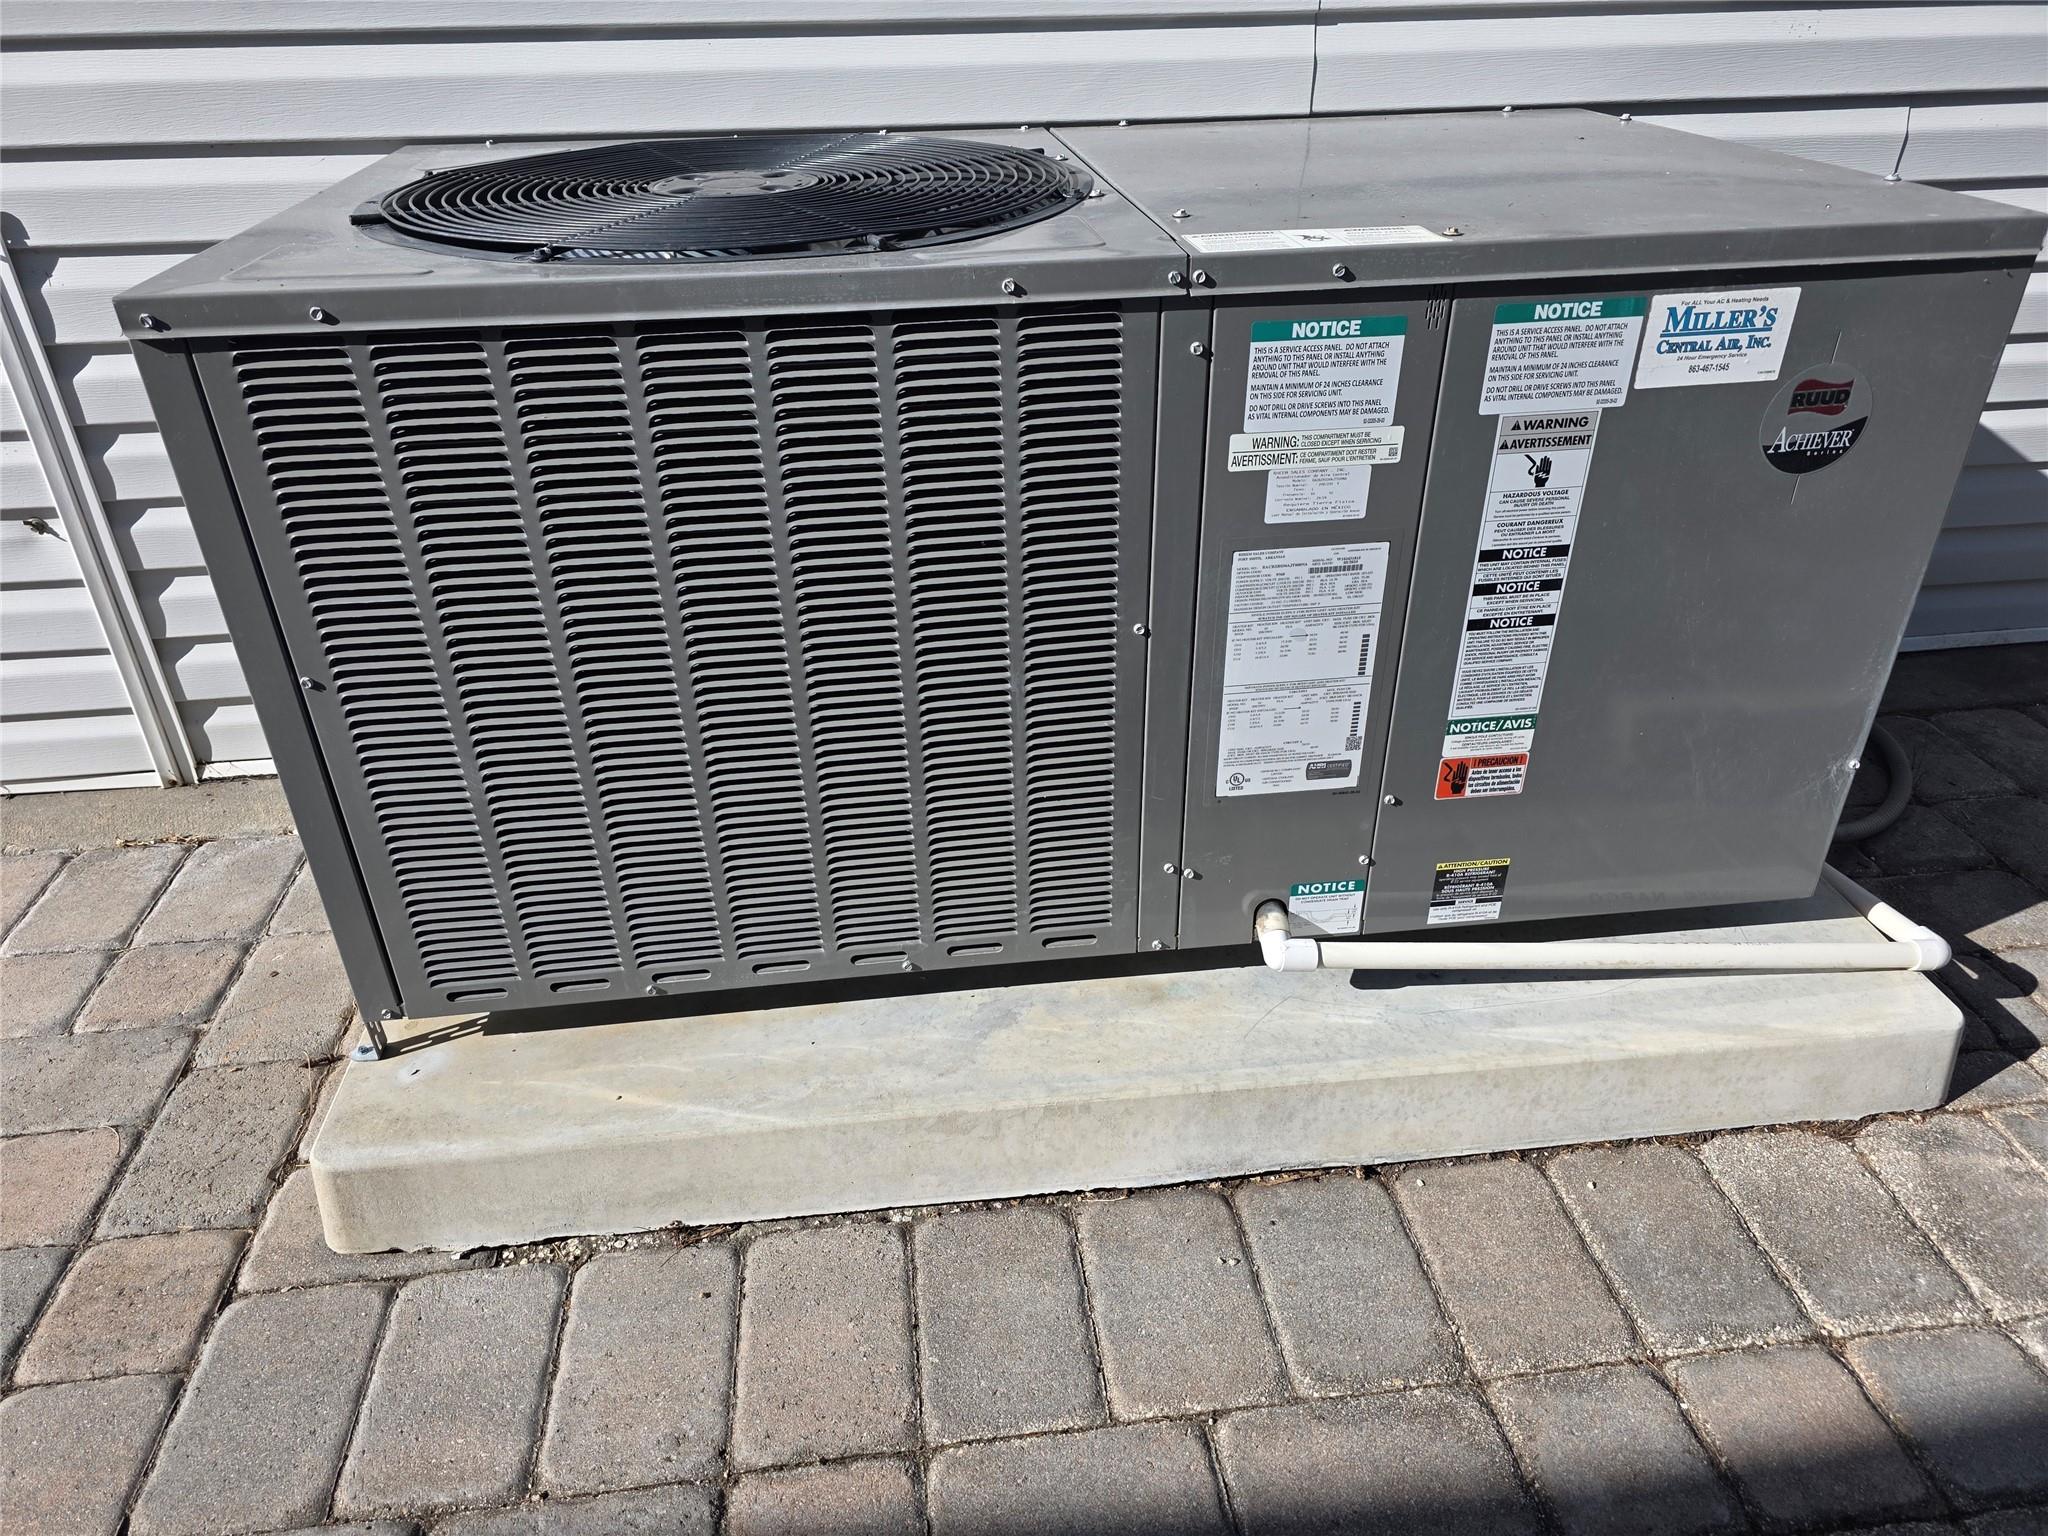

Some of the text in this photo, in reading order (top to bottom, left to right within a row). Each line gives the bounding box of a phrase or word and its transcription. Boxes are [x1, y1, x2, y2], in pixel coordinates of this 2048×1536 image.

[1534, 301, 1602, 319] NOTICE
[1292, 320, 1361, 337] NOTICE
[1509, 328, 1515, 336] IS
[1515, 328, 1520, 336] A
[1520, 327, 1542, 335] SERVICE
[1543, 326, 1563, 334] ACCESS
[1585, 324, 1594, 332] DO
[1594, 323, 1607, 331] NOT
[1606, 322, 1628, 330] ATTACH
[1494, 336, 1523, 345] ANYTHING
[1545, 334, 1562, 342] PANEL
[1594, 331, 1623, 339] ANYTHING
[1254, 341, 1390, 354] THIS IS A SERVICE ACCESS PANEL. DO NOT ATTACH
[1492, 345, 1517, 353] AROUND
[1517, 344, 1531, 352] UNIT
[1532, 343, 1546, 351] THAT
[1547, 342, 1568, 350] WOULD
[1568, 340, 1597, 348] INTERFERE
[1253, 354, 1282, 362] ANYTHING
[1284, 354, 1292, 362] TO
[1292, 353, 1305, 361] THIS
[1324, 352, 1332, 360] OR
[1333, 351, 1354, 359] INSTALL
[1355, 350, 1385, 358] ANYTHING
[1491, 350, 1558, 361] REMOVAL OF THIS PANEL.
[1252, 363, 1277, 371] AROUND
[1277, 362, 1292, 370] UNIT
[1330, 359, 1359, 367] INTERFERE
[1489, 365, 1517, 373] MAINTAIN
[1523, 363, 1551, 371] MINIMUM
[1552, 362, 1560, 370] OF
[1588, 359, 1618, 368] CLEARANCE
[1688, 362, 1729, 373] 863-467-1545
[1251, 371, 1278, 379] REMOVAL
[1279, 370, 1287, 378] OF
[1352, 378, 1383, 386] CLEARANCE
[1249, 392, 1258, 400] ON
[1273, 391, 1285, 399] SIDE
[1298, 389, 1327, 398] SERVICING
[1328, 388, 1342, 396] UNIT.
[1790, 389, 1851, 408] RUUD
[1249, 404, 1258, 412] DO
[1271, 403, 1286, 411] DRILL
[1287, 402, 1296, 410] OR
[1296, 402, 1313, 410] DRIVE
[1314, 400, 1336, 408] SCREWS
[1352, 399, 1364, 407] THIS
[1364, 398, 1381, 406] PANEL
[1256, 412, 1271, 420] VITAL
[1299, 409, 1338, 417] COMPONENTS
[1360, 406, 1389, 414] DAMAGED.
[1524, 416, 1588, 430] WARNING
[1252, 436, 1299, 449] WARNING:
[1510, 434, 1591, 449] AVERTISSEMENT
[1231, 452, 1298, 467] AVERTISSMENT:
[1527, 518, 1563, 526] DANGEREUX
[1502, 547, 1546, 559] NOTICE
[1496, 581, 1540, 594] NOTICE
[1490, 616, 1533, 628] NOTICE
[1450, 718, 1531, 733] NOTICE/AVIS
[1298, 881, 1355, 894] NOTICE
